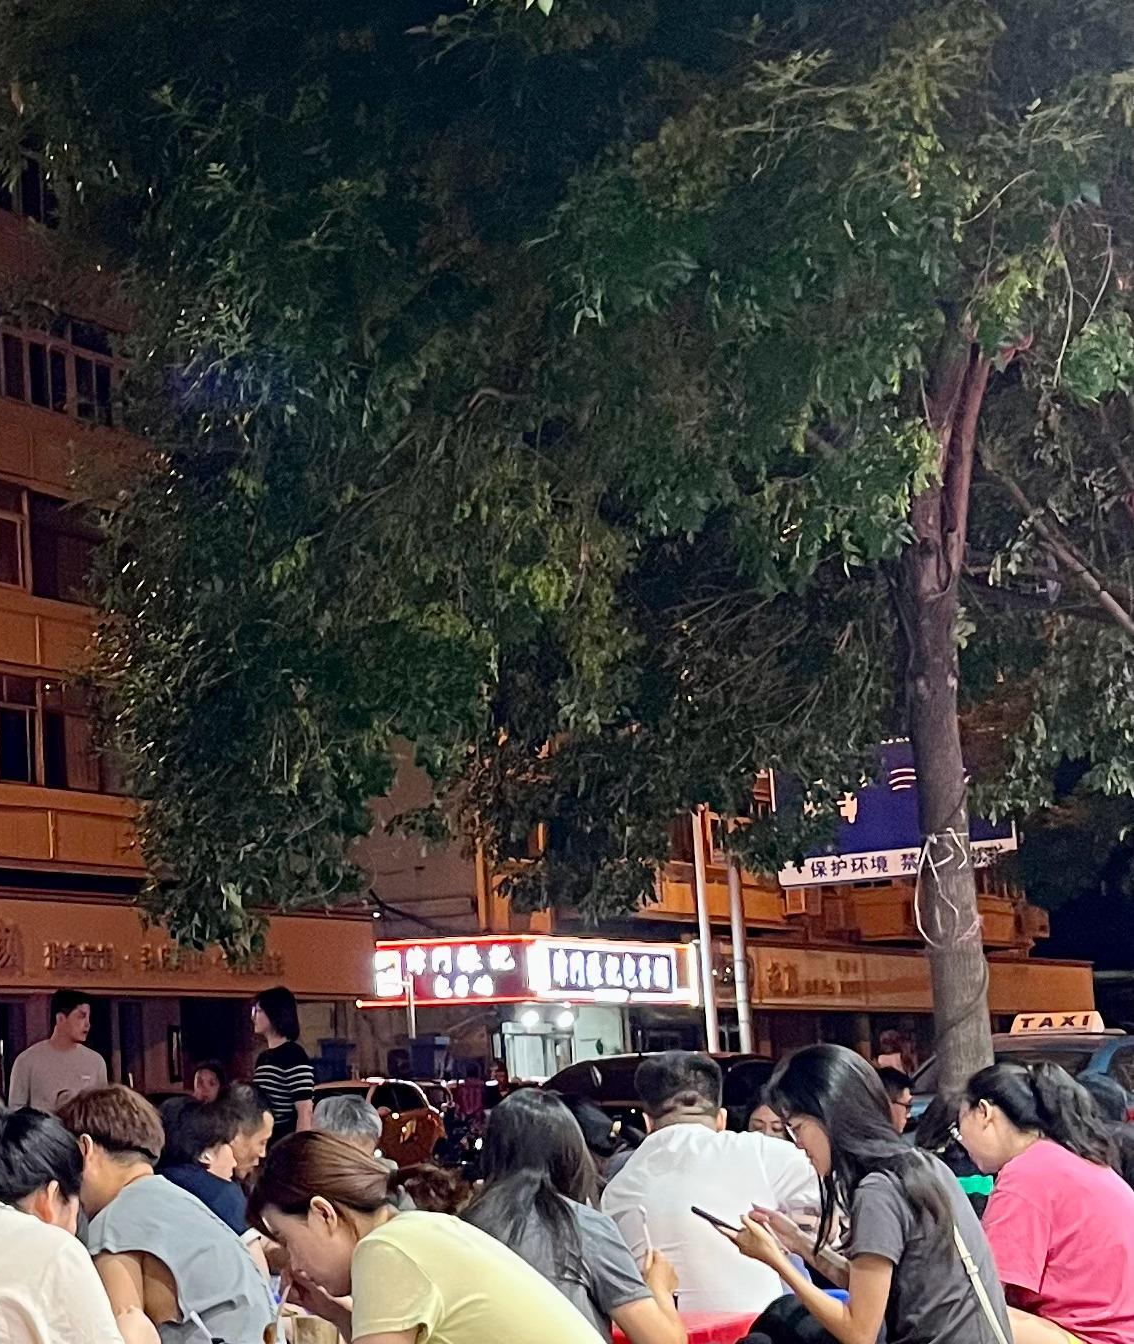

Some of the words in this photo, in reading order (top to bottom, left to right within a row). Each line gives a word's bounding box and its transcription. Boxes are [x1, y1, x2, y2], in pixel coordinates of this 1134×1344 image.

[810, 856, 889, 878] 保护环境
[1020, 1015, 1090, 1028] TAXI
